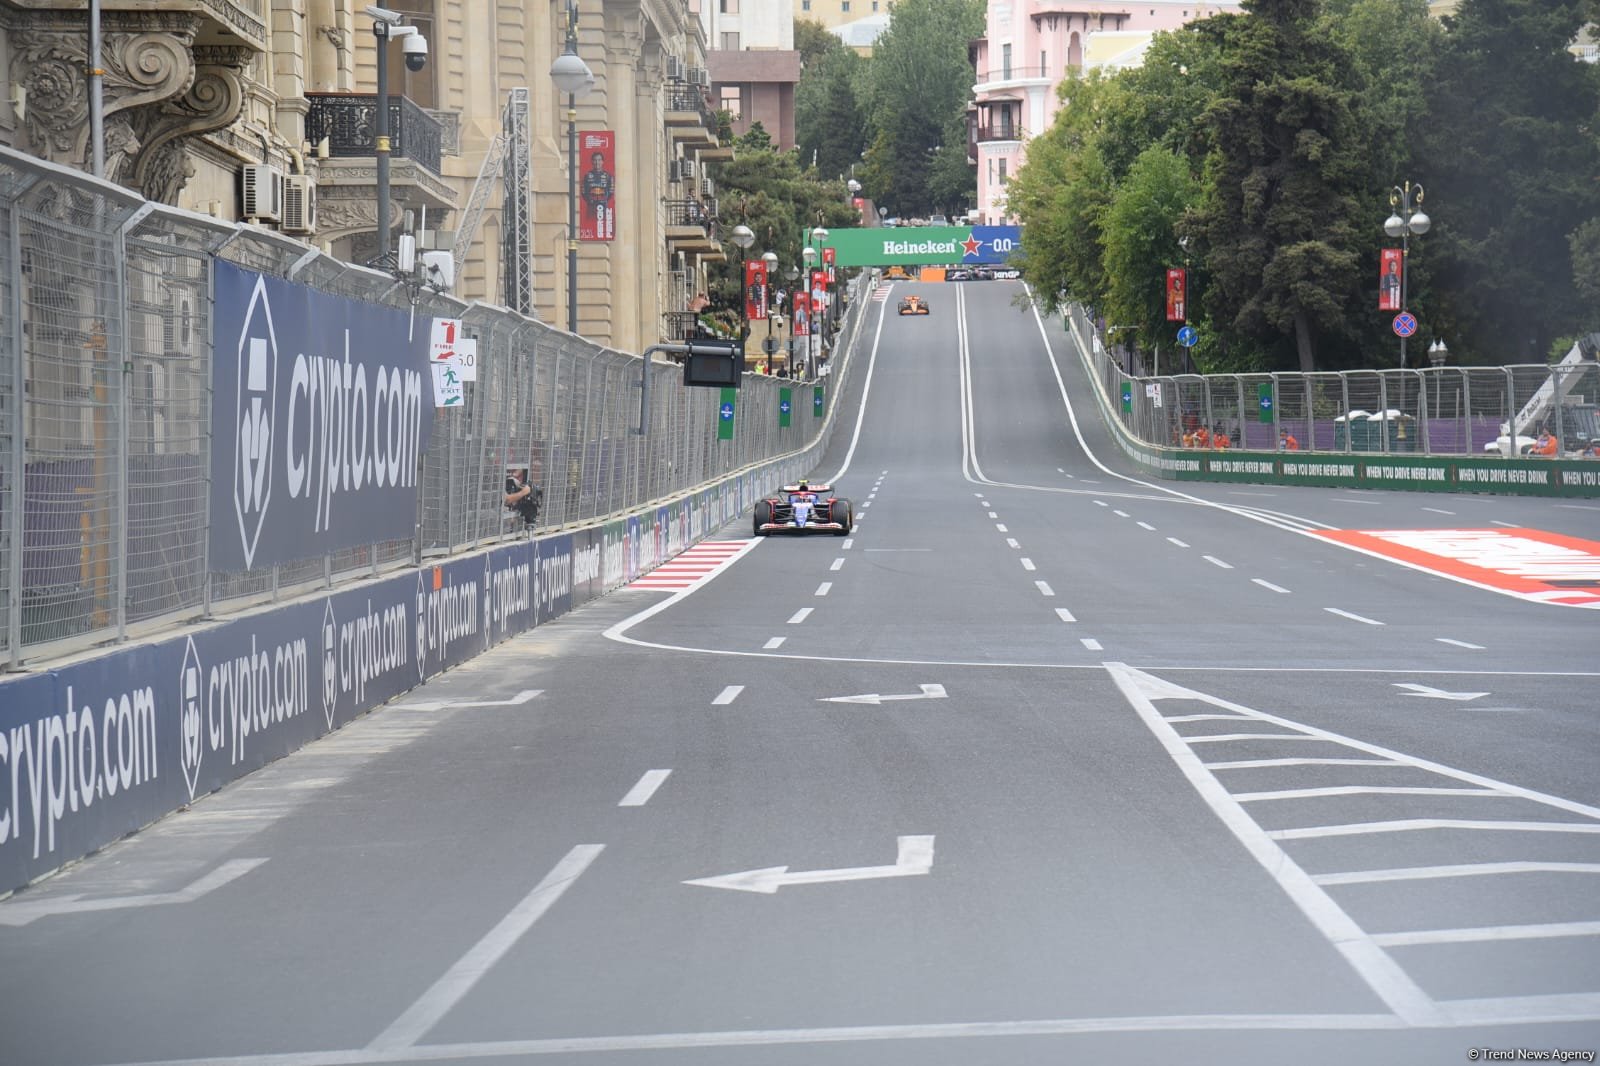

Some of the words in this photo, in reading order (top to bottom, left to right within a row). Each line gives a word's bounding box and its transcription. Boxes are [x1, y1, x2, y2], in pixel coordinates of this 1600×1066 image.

[287, 329, 422, 533] crypto.com
[1209, 461, 1222, 472] WHEN
[1222, 461, 1232, 473] YOU
[1232, 461, 1245, 473] DRIVE
[1245, 462, 1259, 473] NEVER
[1259, 462, 1274, 474] DRINK
[1283, 463, 1298, 475] WHEN
[1298, 464, 1308, 475] YOU
[1308, 464, 1323, 476] DRIVE
[1323, 465, 1339, 476] NEVER
[1339, 465, 1355, 477] DRINK
[1366, 466, 1382, 479] WHEN
[1382, 467, 1394, 479] YOU
[1394, 467, 1410, 480] DRIVE
[1410, 468, 1427, 480] NEVER
[1427, 468, 1446, 481] DRINK
[1458, 468, 1476, 481] WHEN
[1476, 469, 1489, 482] YOU
[1489, 470, 1507, 482] DRIVE
[1507, 470, 1527, 483] NEVER
[1528, 471, 1548, 484] DRINK
[1562, 472, 1581, 485] WHEN
[1582, 472, 1596, 485] YOU
[428, 572, 477, 662] crypto.com
[493, 556, 530, 633] crypto.com
[341, 599, 407, 705] crypto.com
[209, 634, 308, 765] crypto.com
